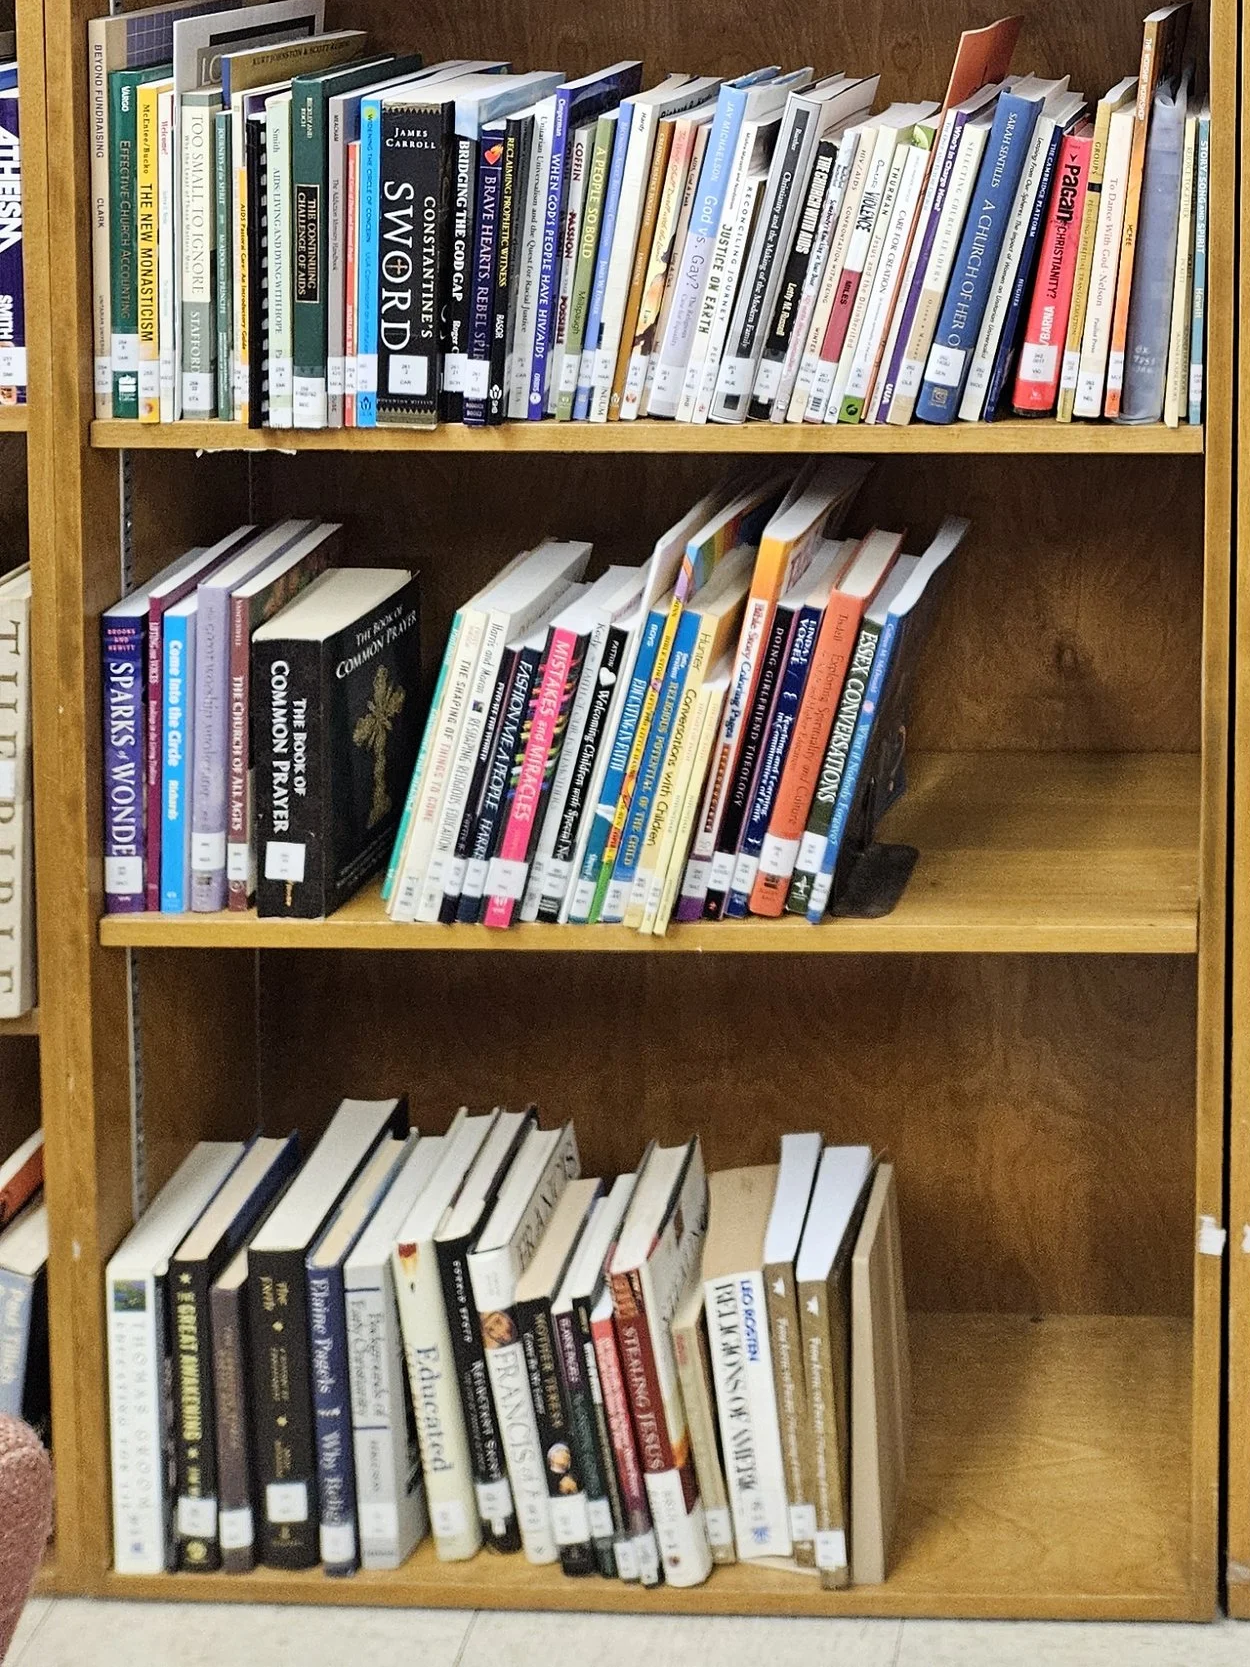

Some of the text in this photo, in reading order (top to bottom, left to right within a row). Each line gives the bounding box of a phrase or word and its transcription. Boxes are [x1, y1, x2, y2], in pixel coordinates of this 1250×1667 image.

[94, 44, 106, 159] BEYOND FUNDRAISING
[385, 137, 437, 149] CARROLL
[395, 127, 428, 138] JAMES
[140, 183, 154, 343] THE NEW MONASTICISM
[380, 180, 415, 352] SWORD
[420, 195, 437, 339] CONSTANTINE'S
[451, 140, 470, 303] BRIDGING THE GOD GAP
[270, 660, 292, 834] COMMON PRAYER
[292, 698, 307, 797] THE BOOK OF
[513, 639, 571, 822] MISTAKES and MIRACLES
[816, 630, 879, 803] ESSEX CONVERSATIONS
[310, 1277, 335, 1395] Elaine Pagels
[623, 1324, 665, 1471] STEALING JESUS
[414, 1344, 454, 1474] Educated
